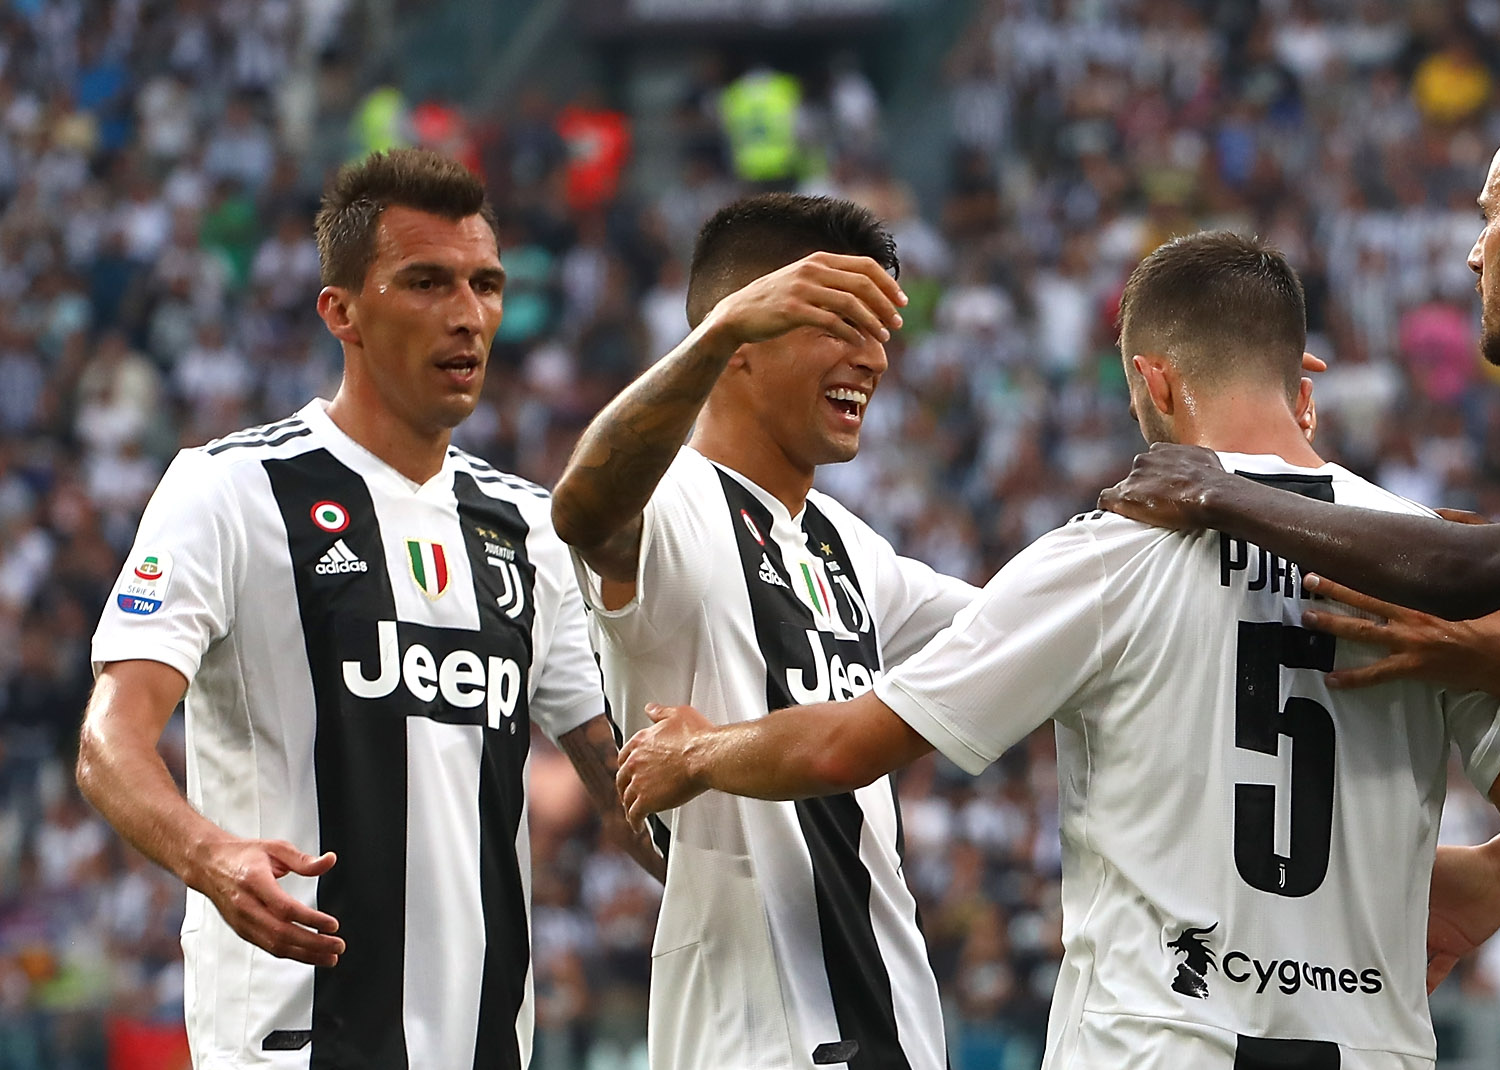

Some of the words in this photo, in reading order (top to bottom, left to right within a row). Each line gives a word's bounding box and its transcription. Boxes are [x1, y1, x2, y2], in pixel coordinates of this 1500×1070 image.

[315, 560, 369, 575] adidas
[126, 584, 147, 596] SERIE
[133, 599, 155, 613] TIM
[342, 621, 520, 730] Jeep
[1234, 621, 1338, 898] 5
[1222, 950, 1383, 997] Cygames
